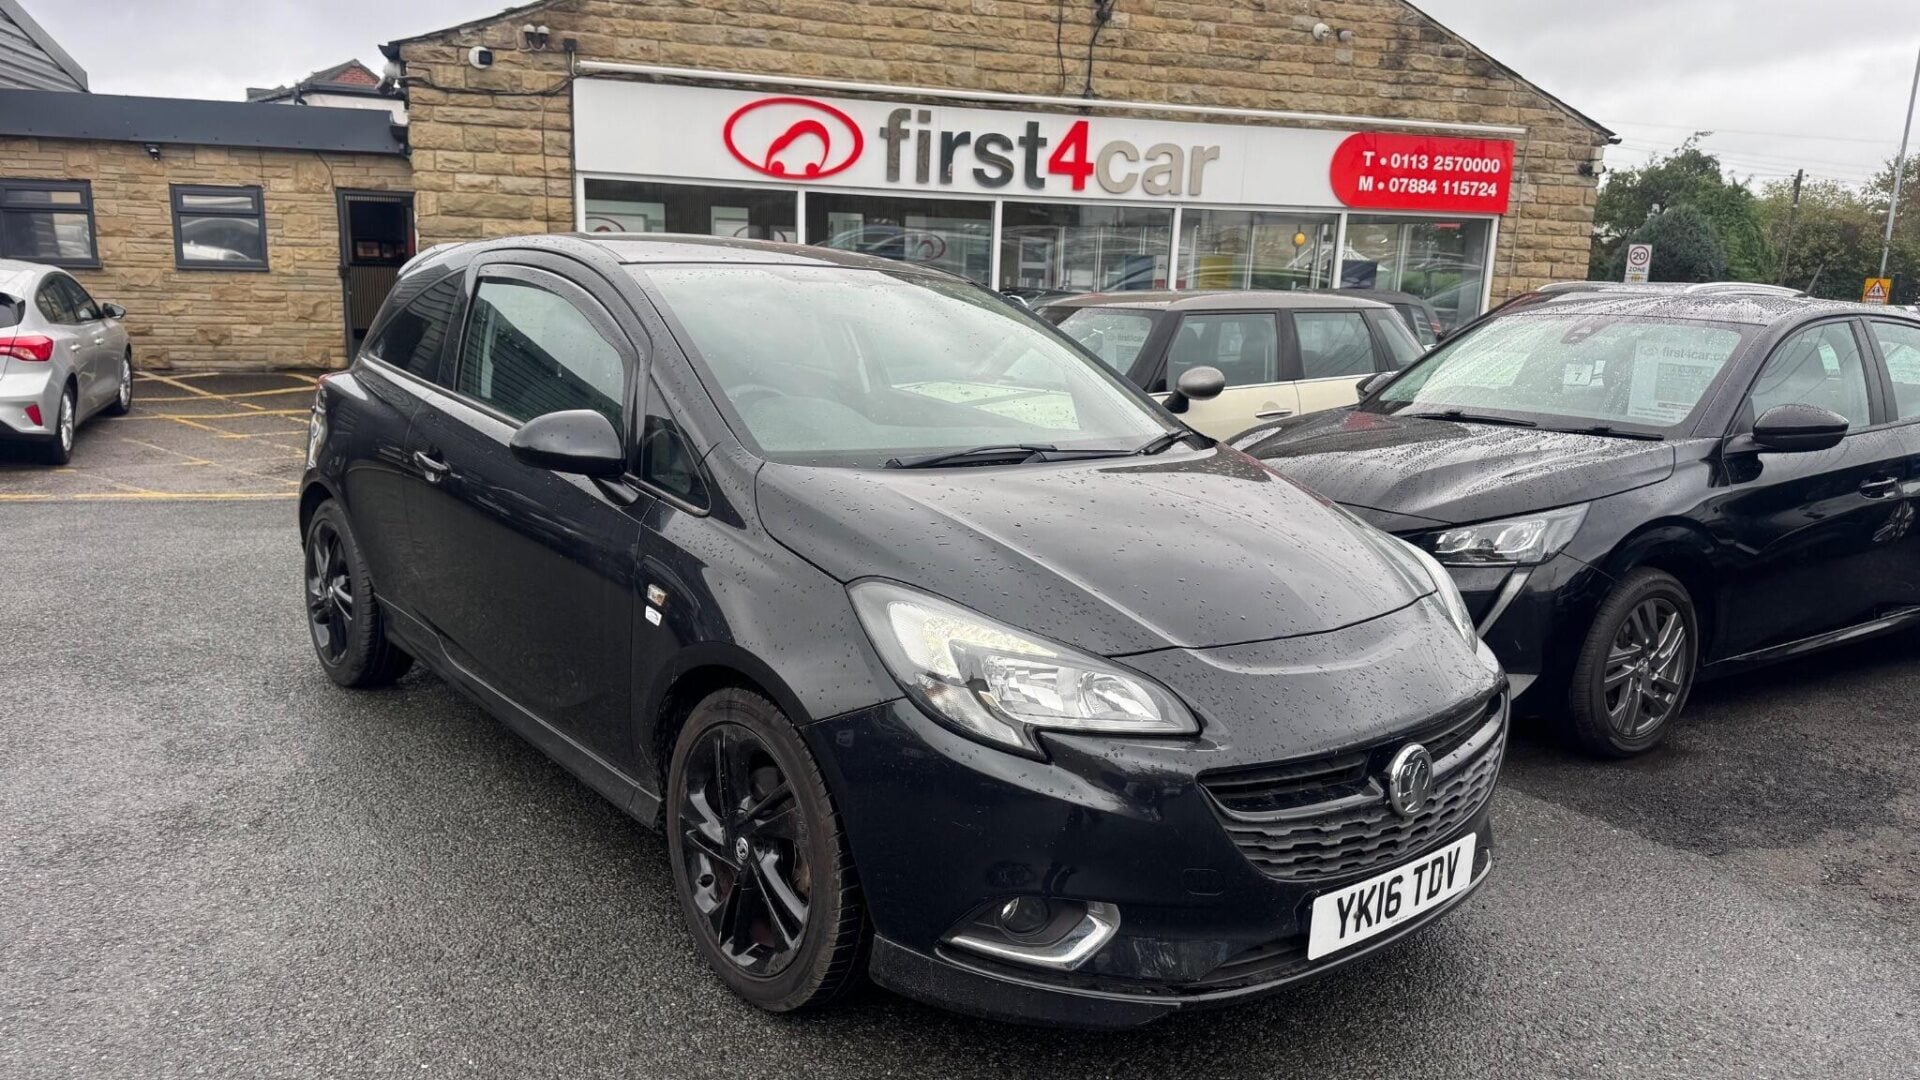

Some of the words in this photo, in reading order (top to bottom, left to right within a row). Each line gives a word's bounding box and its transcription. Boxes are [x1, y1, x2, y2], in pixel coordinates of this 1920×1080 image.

[879, 107, 1221, 196] first4car
[1362, 151, 1375, 166] T
[1390, 153, 1428, 169] 0113
[1433, 155, 1500, 173] 2570000
[1358, 175, 1374, 192] M
[1388, 177, 1437, 193] 07884
[1442, 180, 1497, 197] 115724
[1632, 251, 1646, 261] 20
[1337, 874, 1404, 939] YK16
[1413, 846, 1461, 907] TDV
